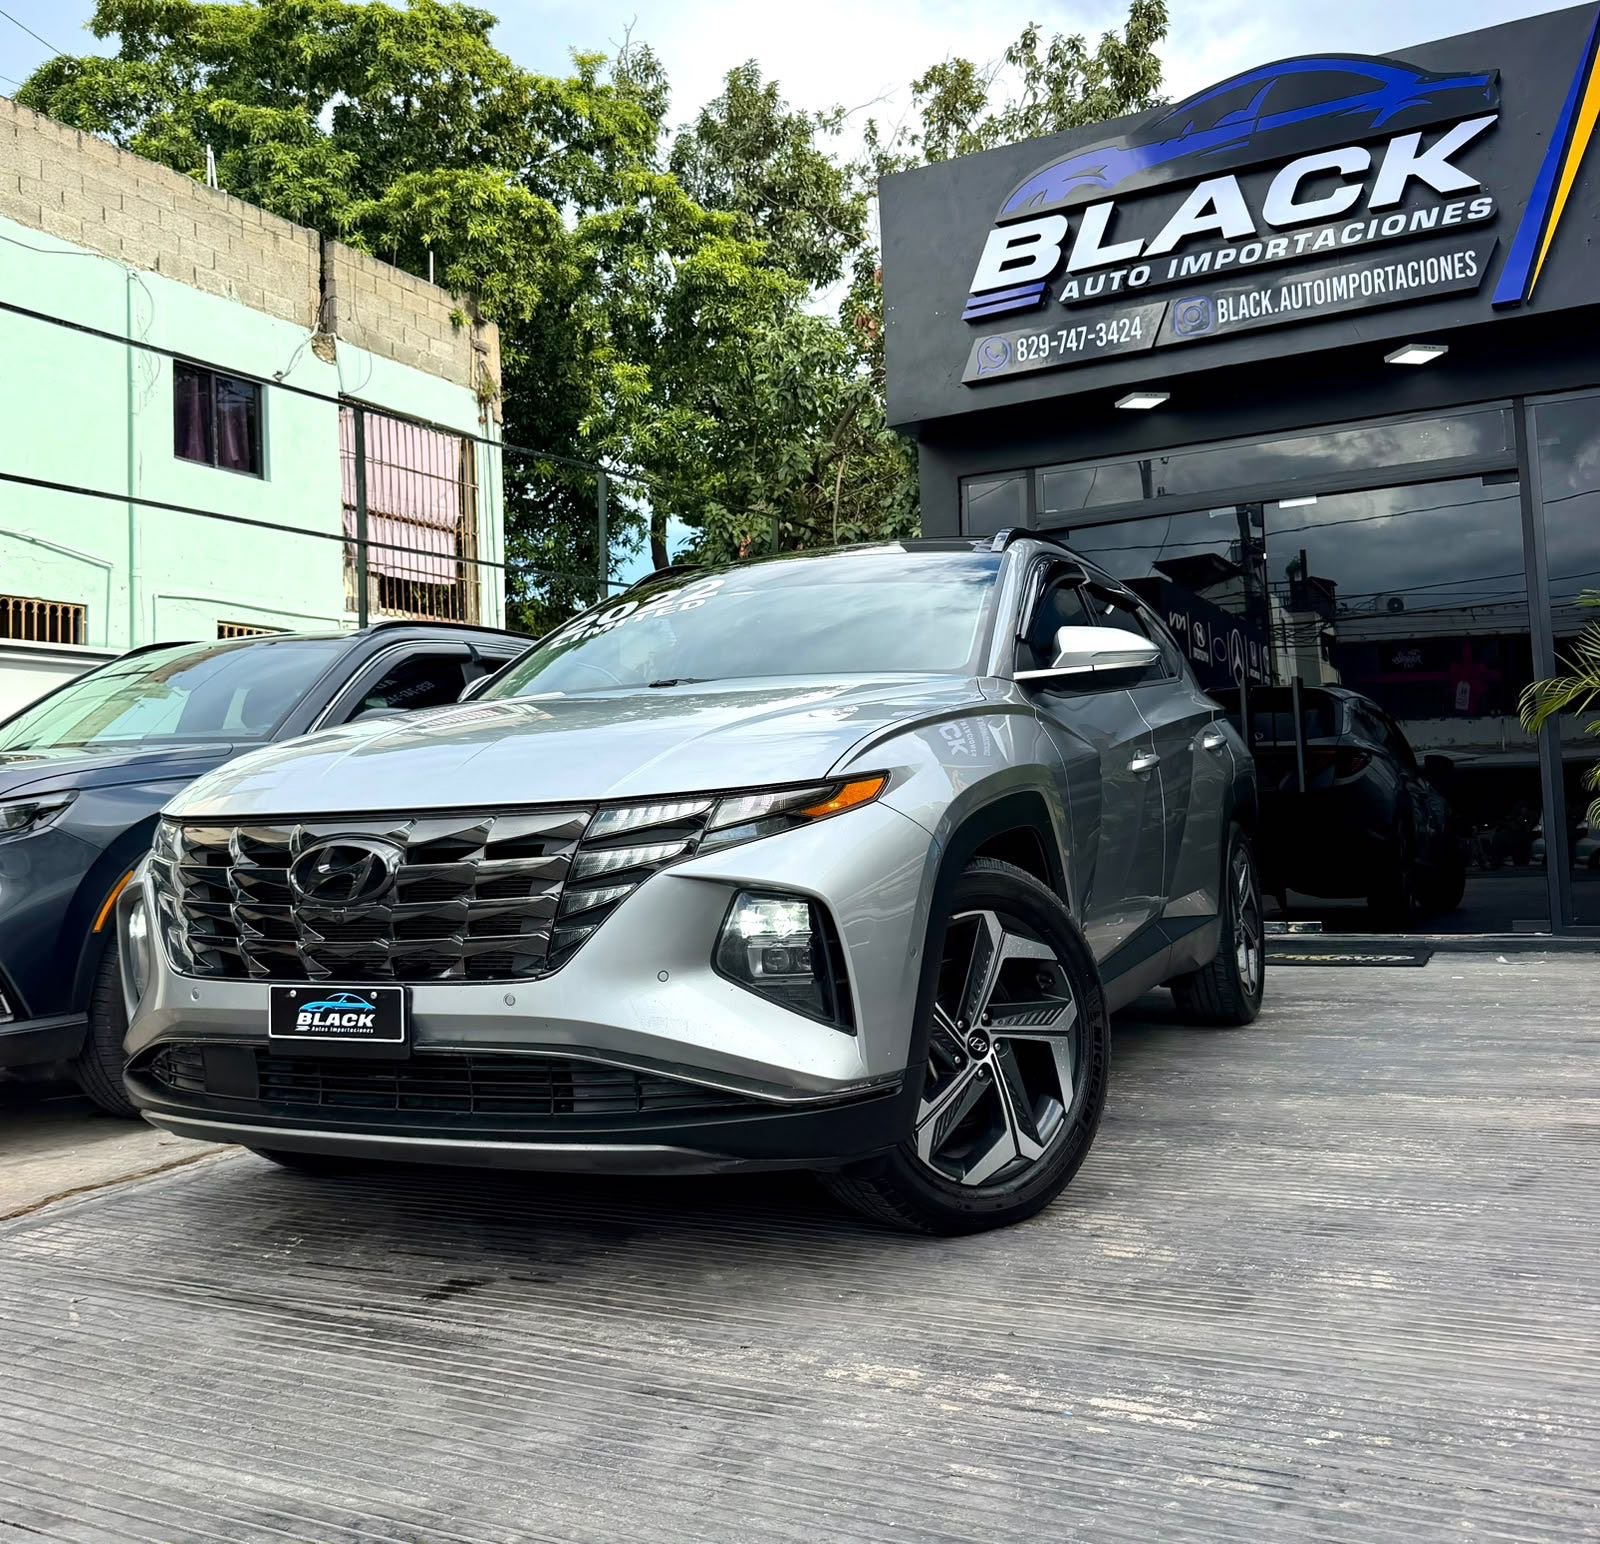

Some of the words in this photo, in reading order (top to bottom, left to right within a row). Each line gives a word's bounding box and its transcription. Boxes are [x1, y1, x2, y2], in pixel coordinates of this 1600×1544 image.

[968, 114, 1499, 295] BLACK
[1059, 264, 1152, 302] AUTO
[1167, 196, 1493, 280] IMPORTACIONES
[1217, 250, 1478, 325] BLACK.AUTOIMPORTACIONES
[1016, 315, 1142, 362] 829-747-3424
[549, 599, 706, 650] LIMITED
[550, 579, 726, 645] 2022
[297, 1012, 376, 1027] BLACK
